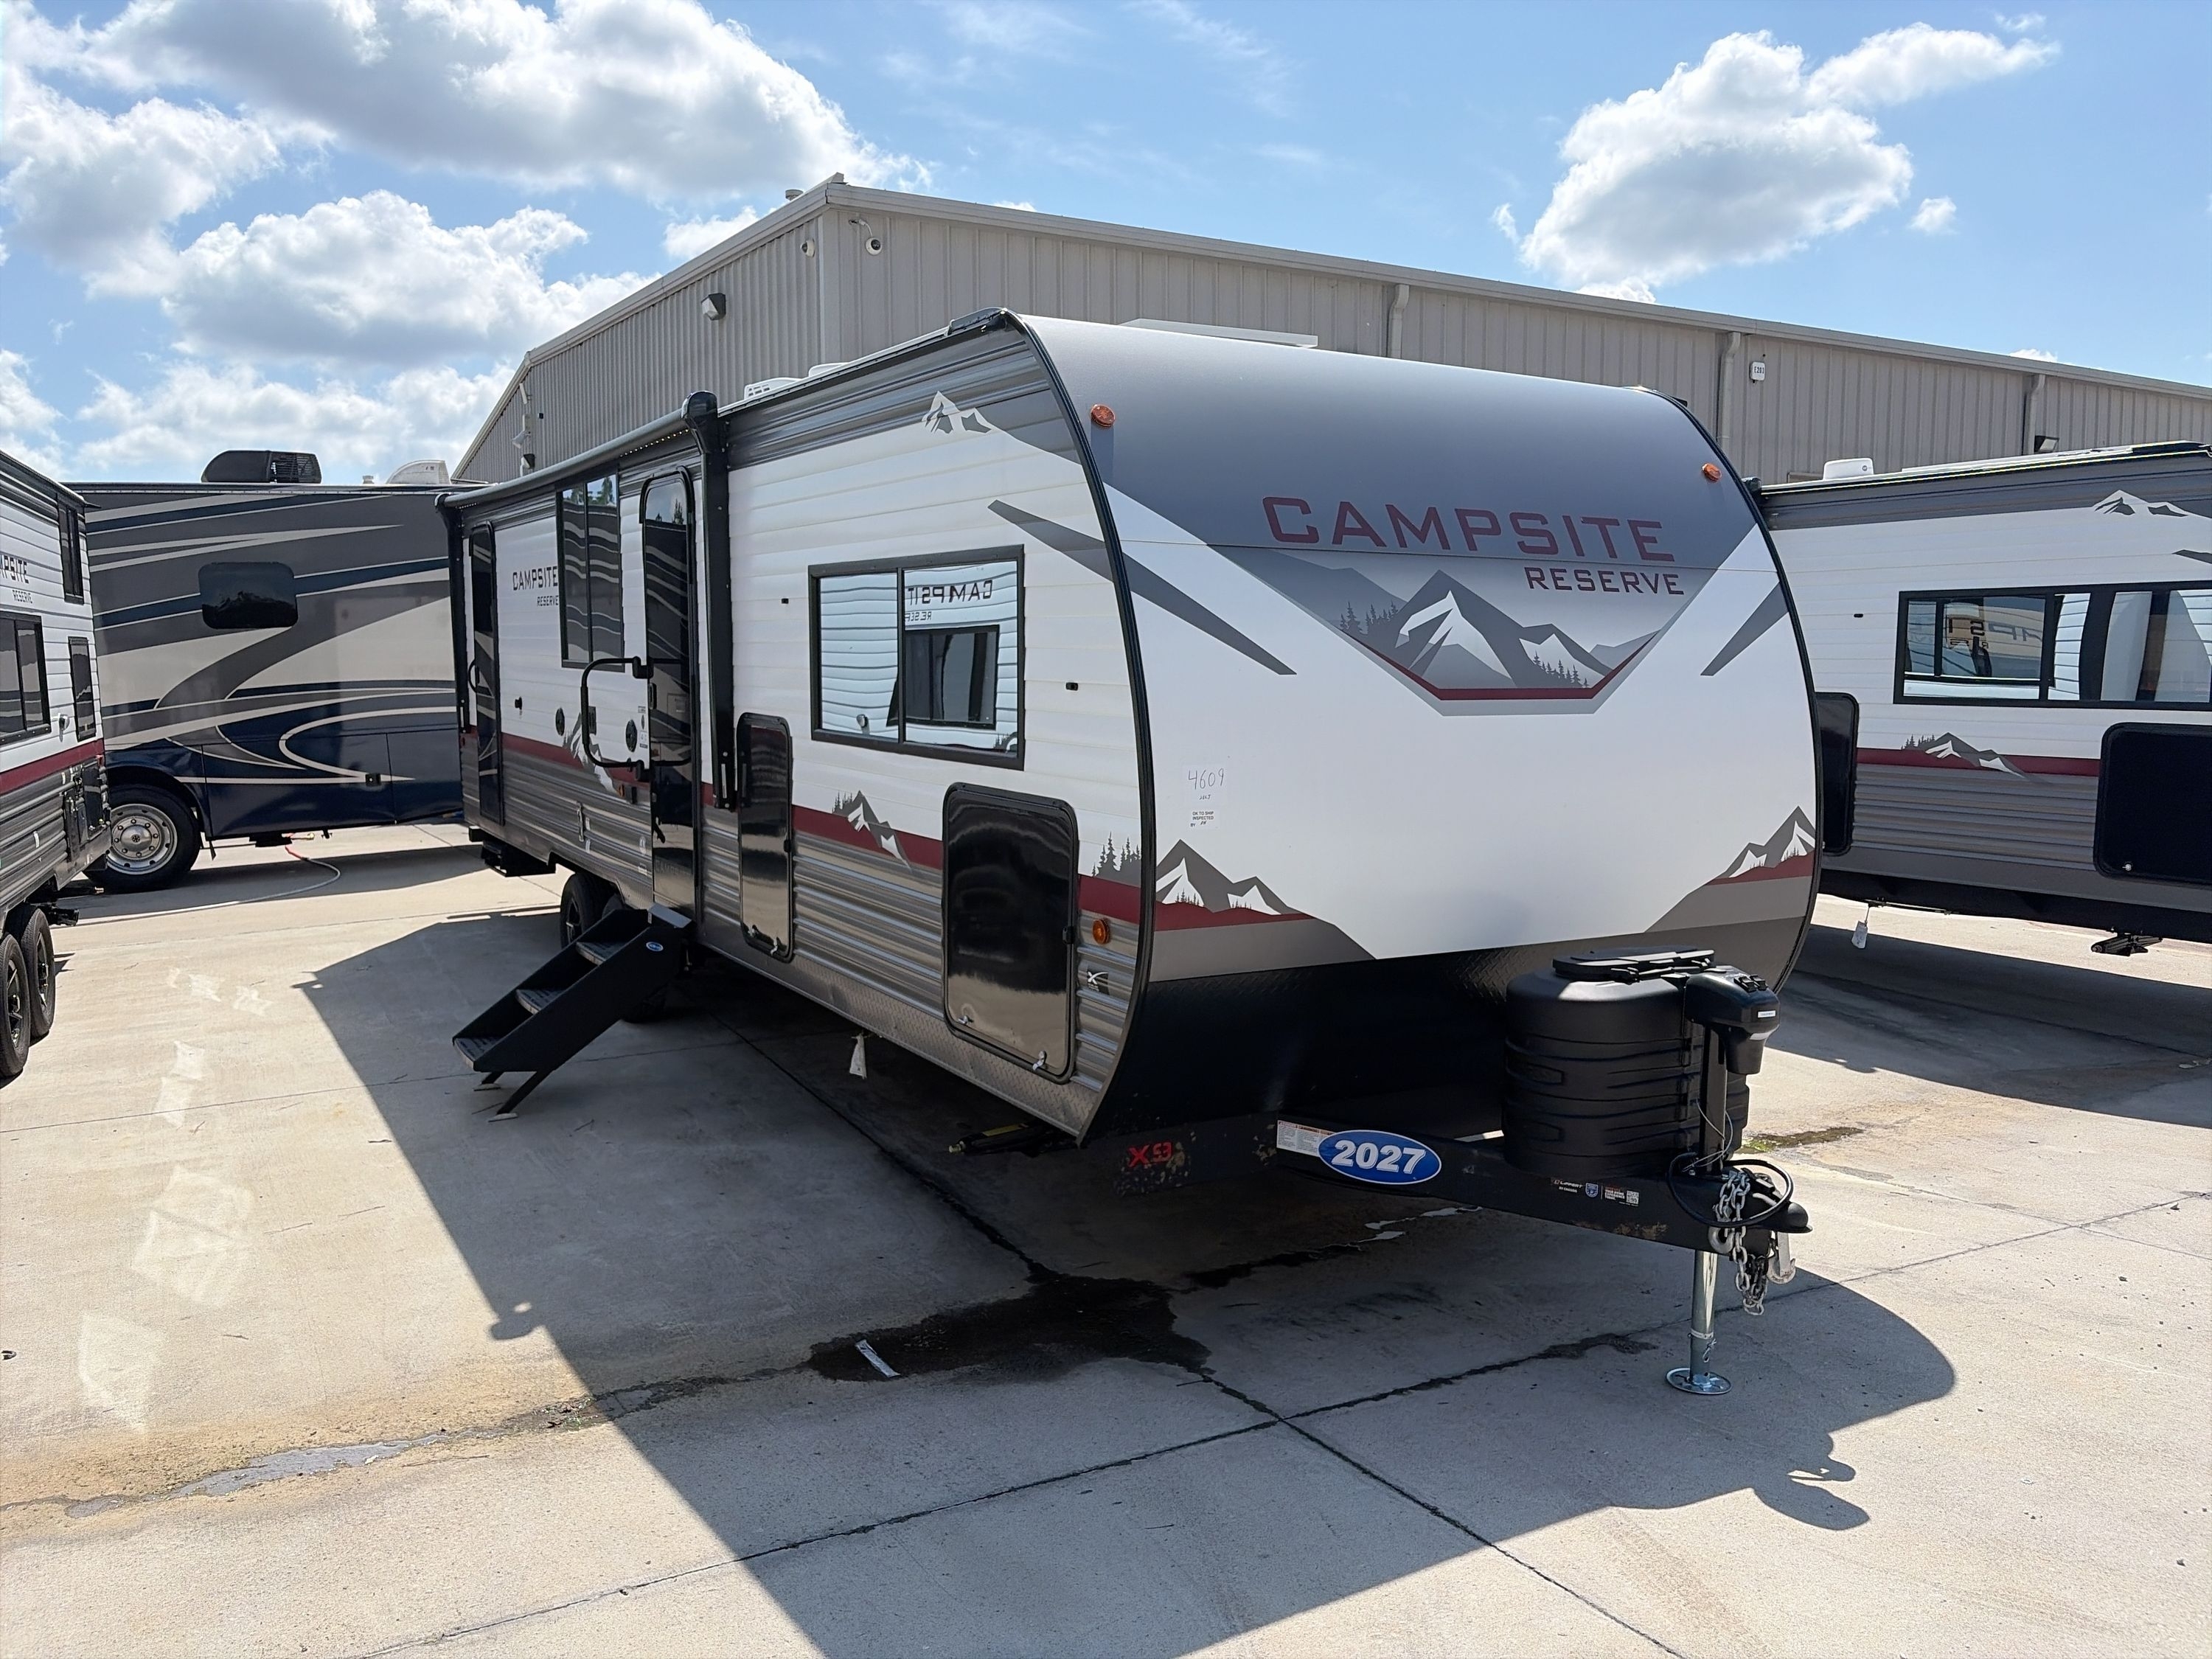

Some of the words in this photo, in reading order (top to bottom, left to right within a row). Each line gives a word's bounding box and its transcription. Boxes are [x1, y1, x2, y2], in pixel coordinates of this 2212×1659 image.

[1262, 496, 1675, 562] CAMPSITE
[512, 566, 558, 591] CAMPSITE
[1524, 566, 1685, 595] RESERVE
[537, 595, 559, 606] RESERVE
[1188, 768, 1224, 790] 4609
[1332, 1139, 1426, 1175] 2027
